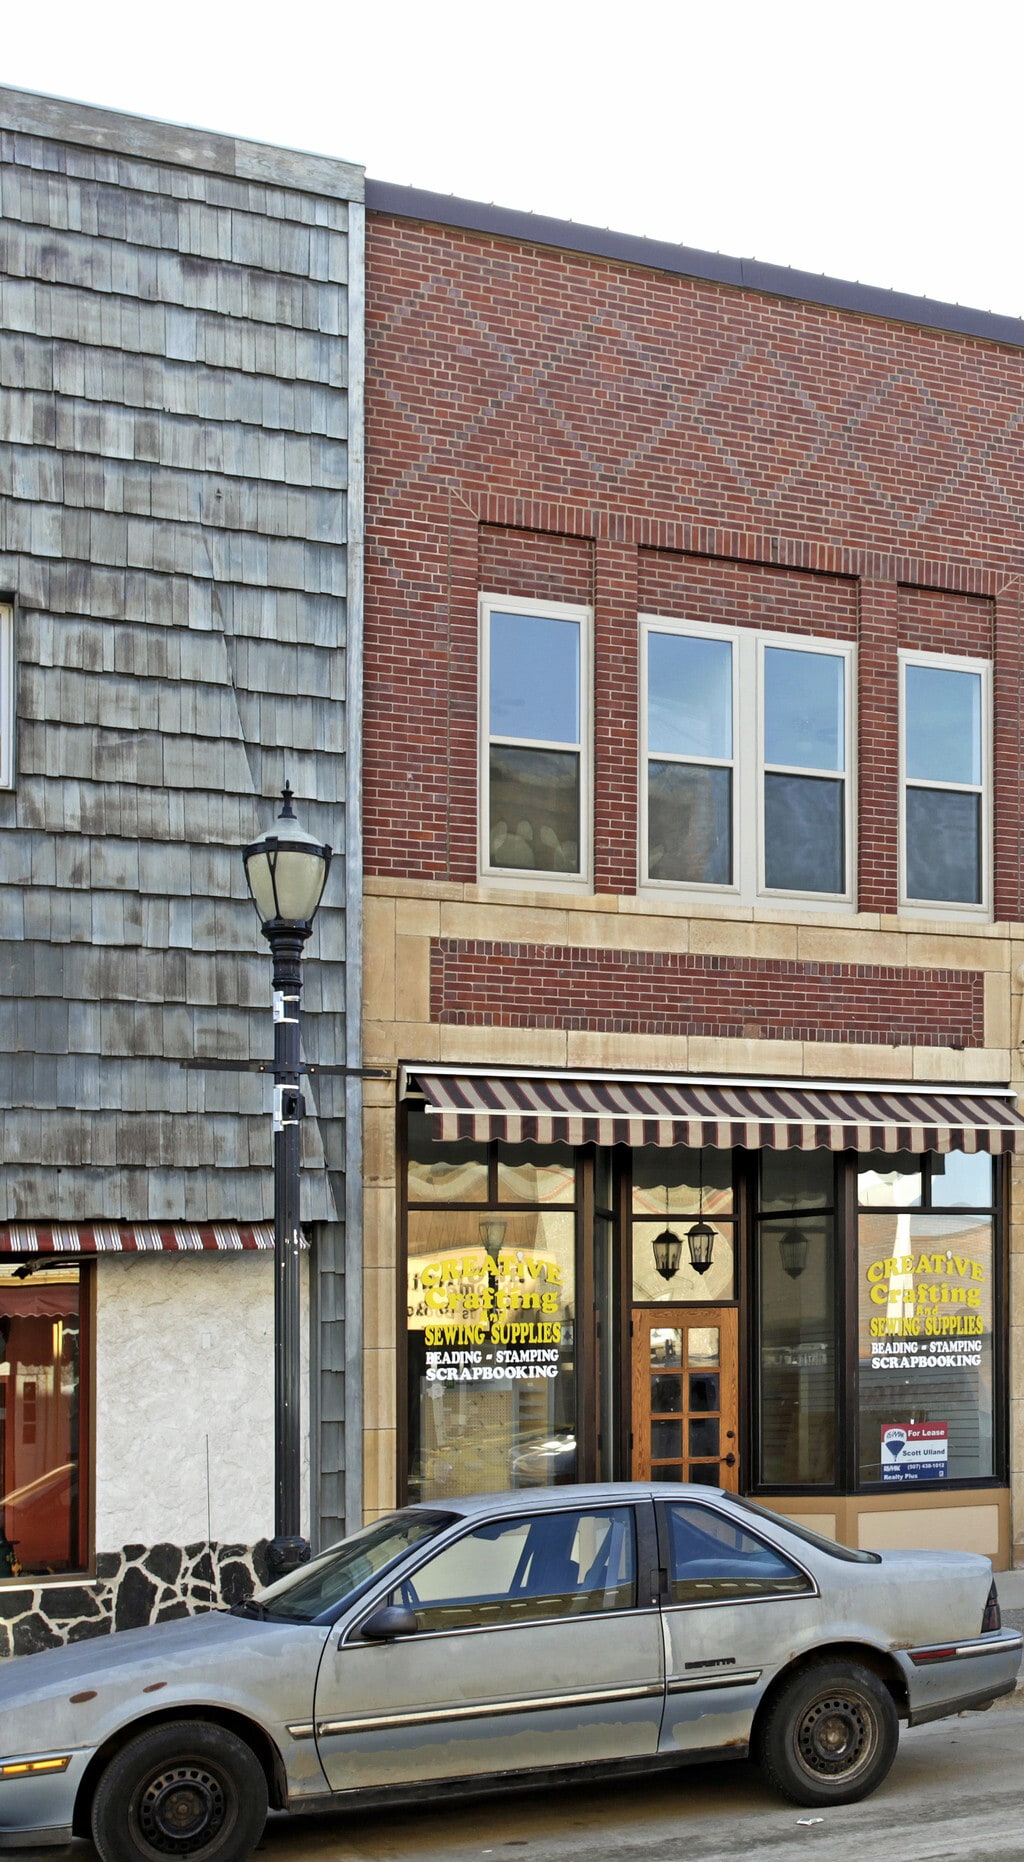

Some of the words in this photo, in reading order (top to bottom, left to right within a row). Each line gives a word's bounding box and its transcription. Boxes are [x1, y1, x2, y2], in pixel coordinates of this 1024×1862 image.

[425, 1288, 558, 1314] Crafting
[870, 1283, 981, 1308] Crafting
[916, 1305, 939, 1315] And
[425, 1324, 485, 1346] SEWING
[491, 1322, 562, 1344] SUPPLIES
[870, 1317, 920, 1337] SEWING
[925, 1315, 984, 1336] SUPPLIES
[871, 1342, 918, 1354] BEADING
[930, 1340, 982, 1353] STAMPING
[426, 1351, 482, 1365] BEADING
[496, 1349, 559, 1363] STAMPING
[871, 1355, 981, 1369] SCRAPBOOKING
[426, 1365, 558, 1381] SCRAPBOOKING
[923, 1448, 945, 1456] Ulland
